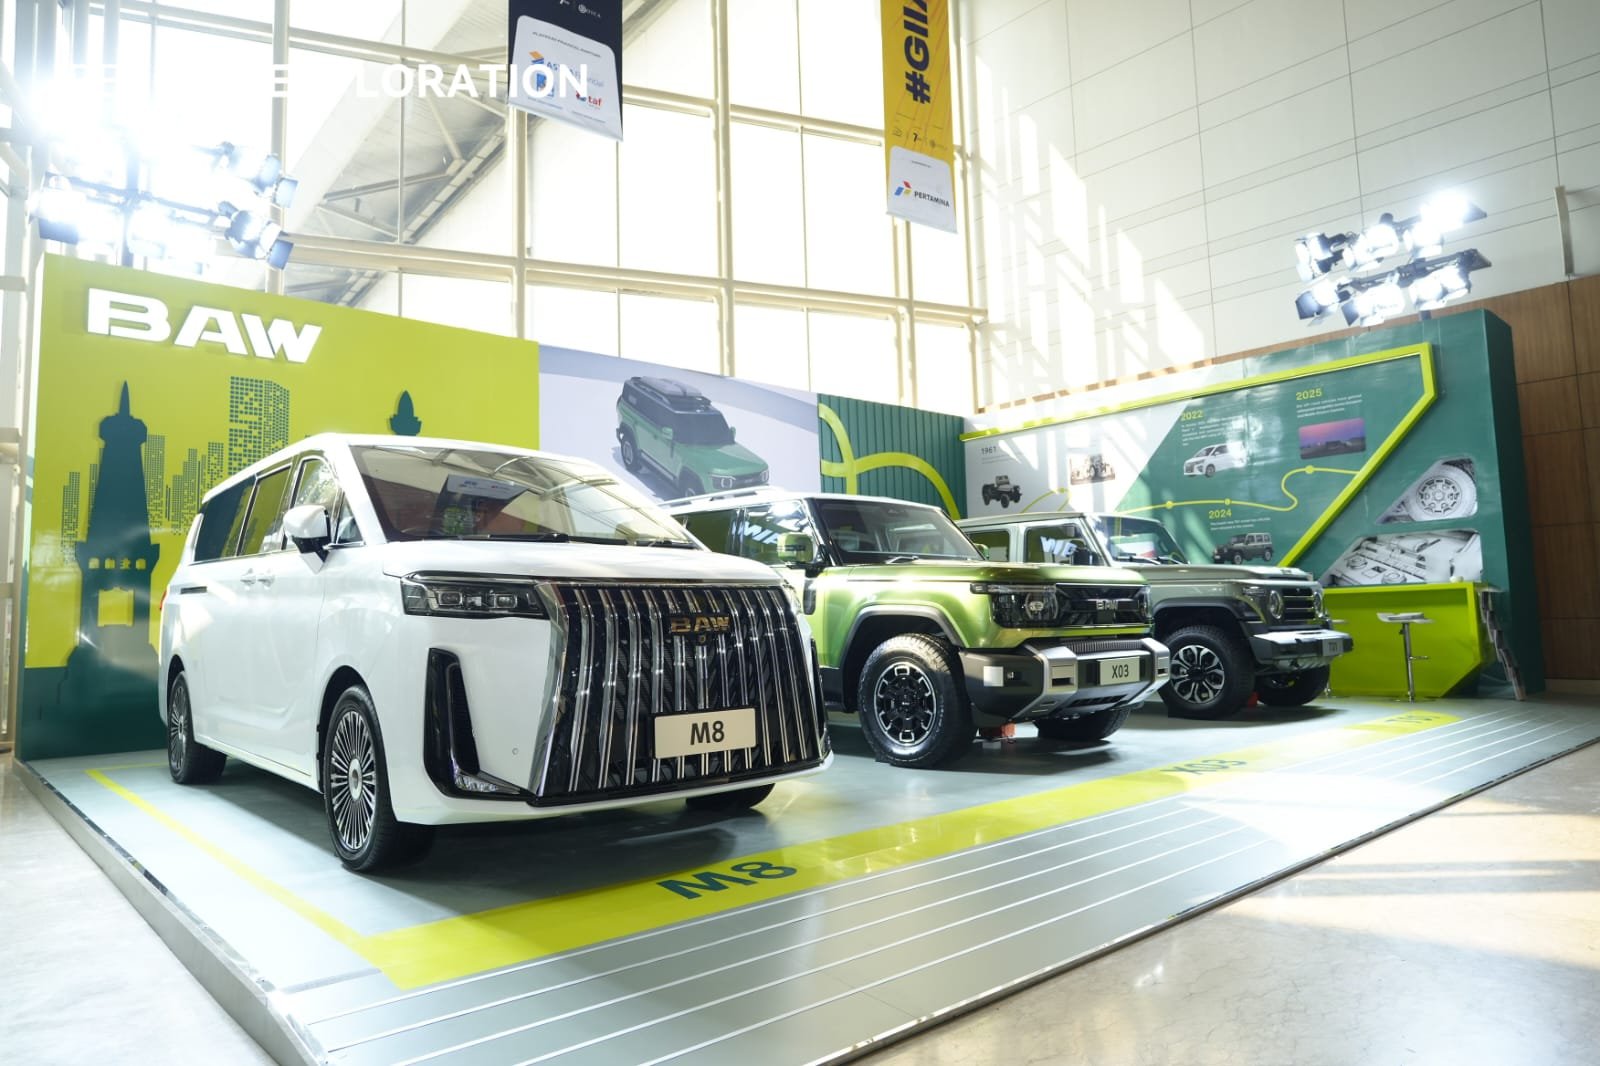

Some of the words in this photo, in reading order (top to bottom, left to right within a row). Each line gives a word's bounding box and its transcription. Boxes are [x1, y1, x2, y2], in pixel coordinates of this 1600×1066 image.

[913, 190, 950, 208] PERTAMINA
[86, 286, 323, 363] BAW
[1295, 388, 1323, 401] 2025
[1180, 410, 1203, 421] 2022
[1208, 509, 1232, 520] 2024
[1096, 600, 1119, 611] BAW
[671, 616, 730, 633] BAW
[1111, 664, 1130, 679] X03
[690, 719, 725, 745] M8
[1161, 757, 1247, 776] X03
[656, 860, 799, 901] M8
